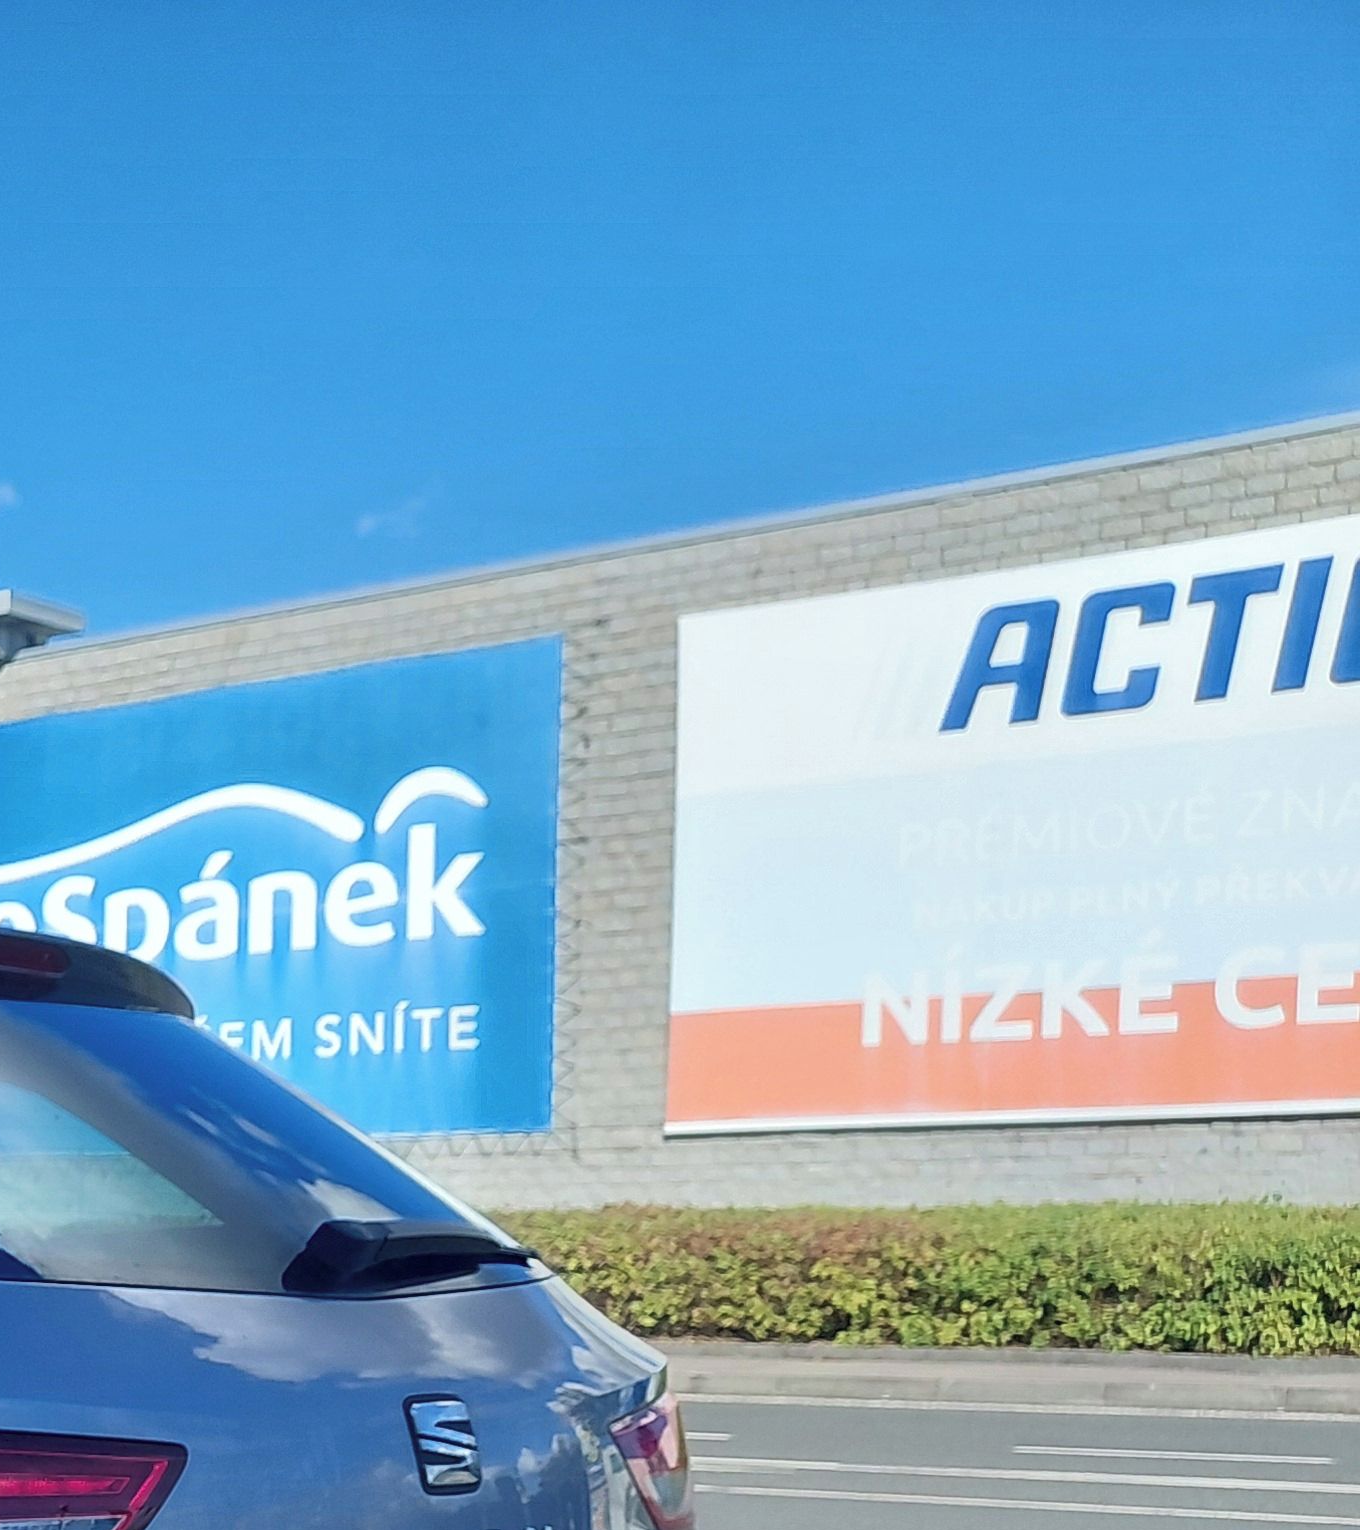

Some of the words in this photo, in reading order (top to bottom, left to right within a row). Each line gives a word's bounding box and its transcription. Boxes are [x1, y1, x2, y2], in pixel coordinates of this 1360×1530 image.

[939, 556, 1360, 733] ACTI
[194, 1013, 292, 1061] EM
[314, 1000, 480, 1058] SNÍTE
[861, 927, 1180, 1048] NÍZKÉ
